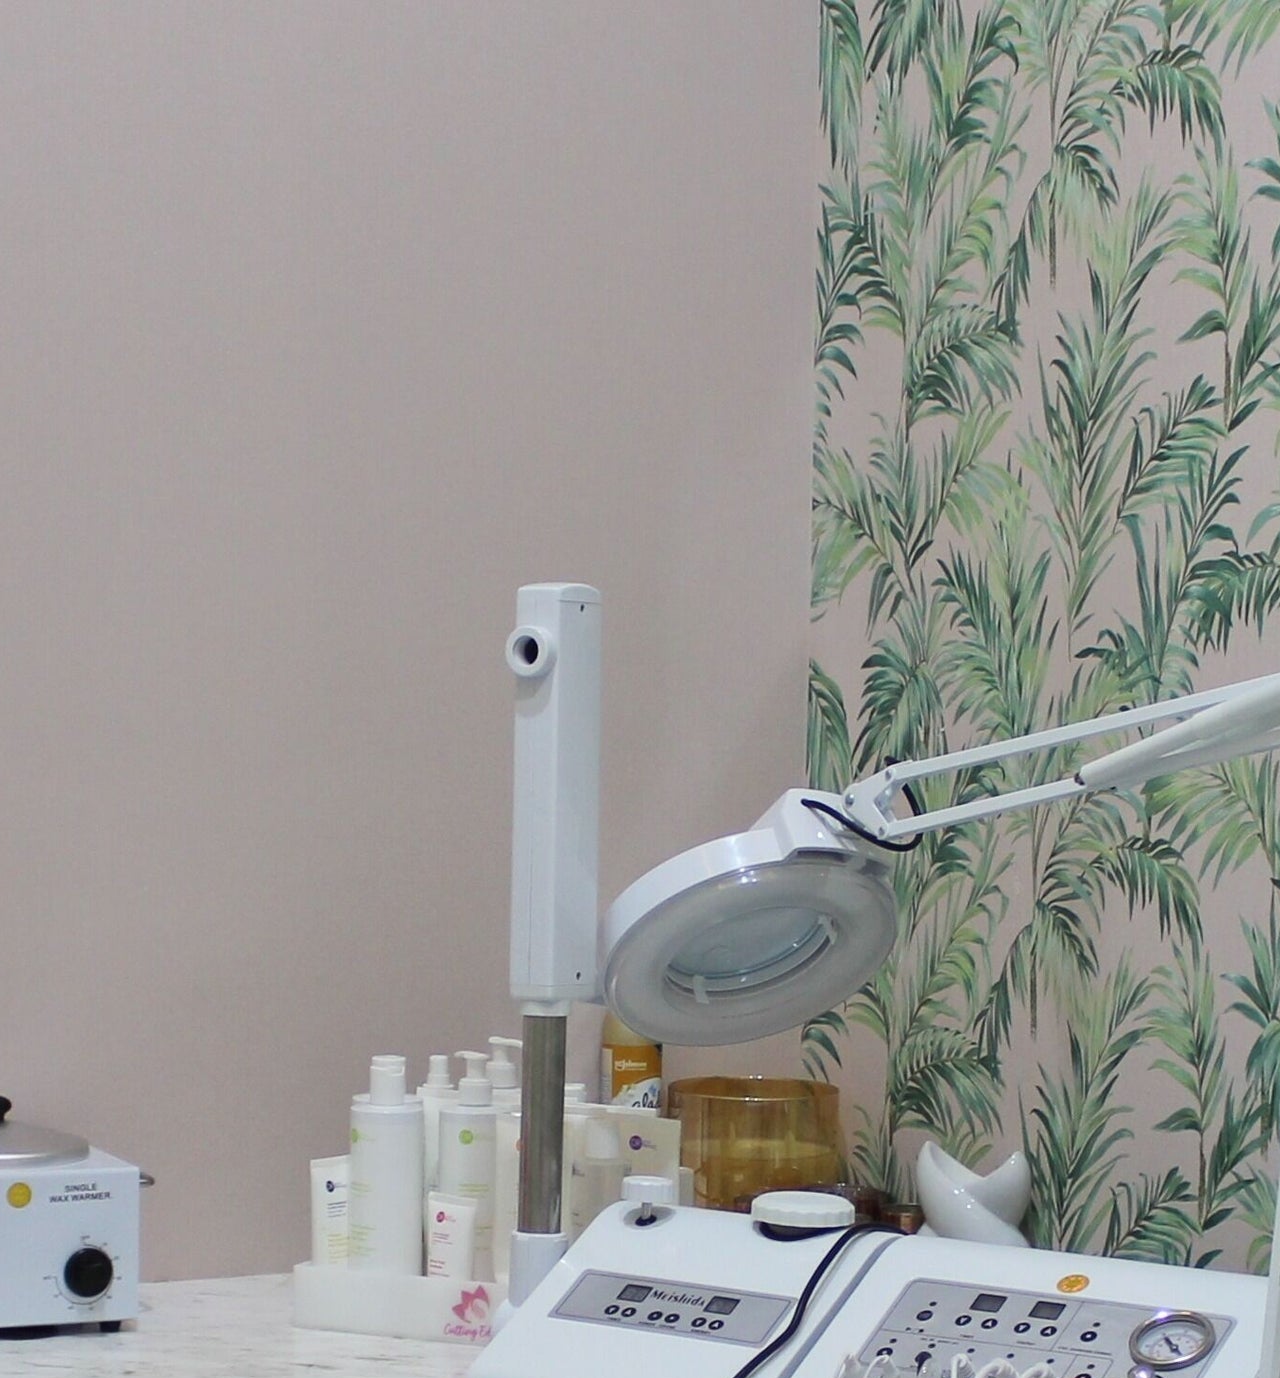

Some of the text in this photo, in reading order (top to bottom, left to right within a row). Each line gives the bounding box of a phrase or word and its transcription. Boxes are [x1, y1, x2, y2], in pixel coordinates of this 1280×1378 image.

[65, 1183, 97, 1192] SINGLE
[49, 1191, 111, 1203] WAX WARMER
[444, 1322, 477, 1341] Cutting
